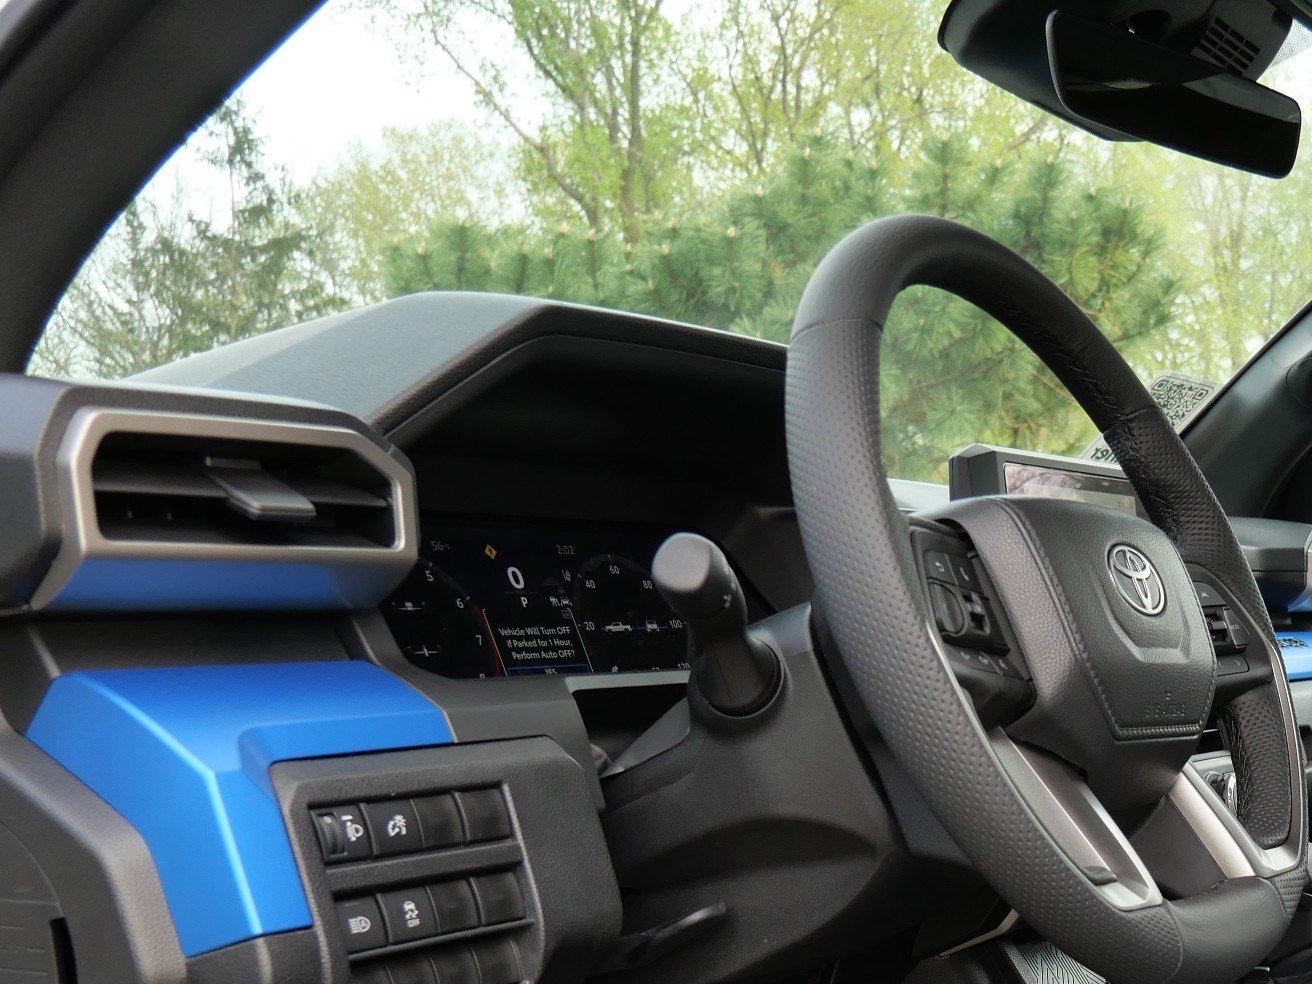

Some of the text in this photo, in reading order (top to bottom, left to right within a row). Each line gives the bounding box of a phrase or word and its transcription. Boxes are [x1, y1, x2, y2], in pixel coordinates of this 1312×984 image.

[609, 565, 620, 575] 60
[425, 570, 434, 582] 5
[507, 566, 525, 590] 0
[585, 579, 596, 589] 40
[642, 580, 653, 590] 80
[456, 598, 465, 609] 6
[521, 597, 528, 609] P
[583, 621, 595, 631] 20
[669, 619, 683, 629] 100
[498, 626, 571, 637] Vehicle Will Turn OFF
[475, 635, 483, 646] 7
[513, 639, 538, 648] Parked
[537, 638, 548, 647] for
[511, 649, 576, 660] Perform Auto OFF?
